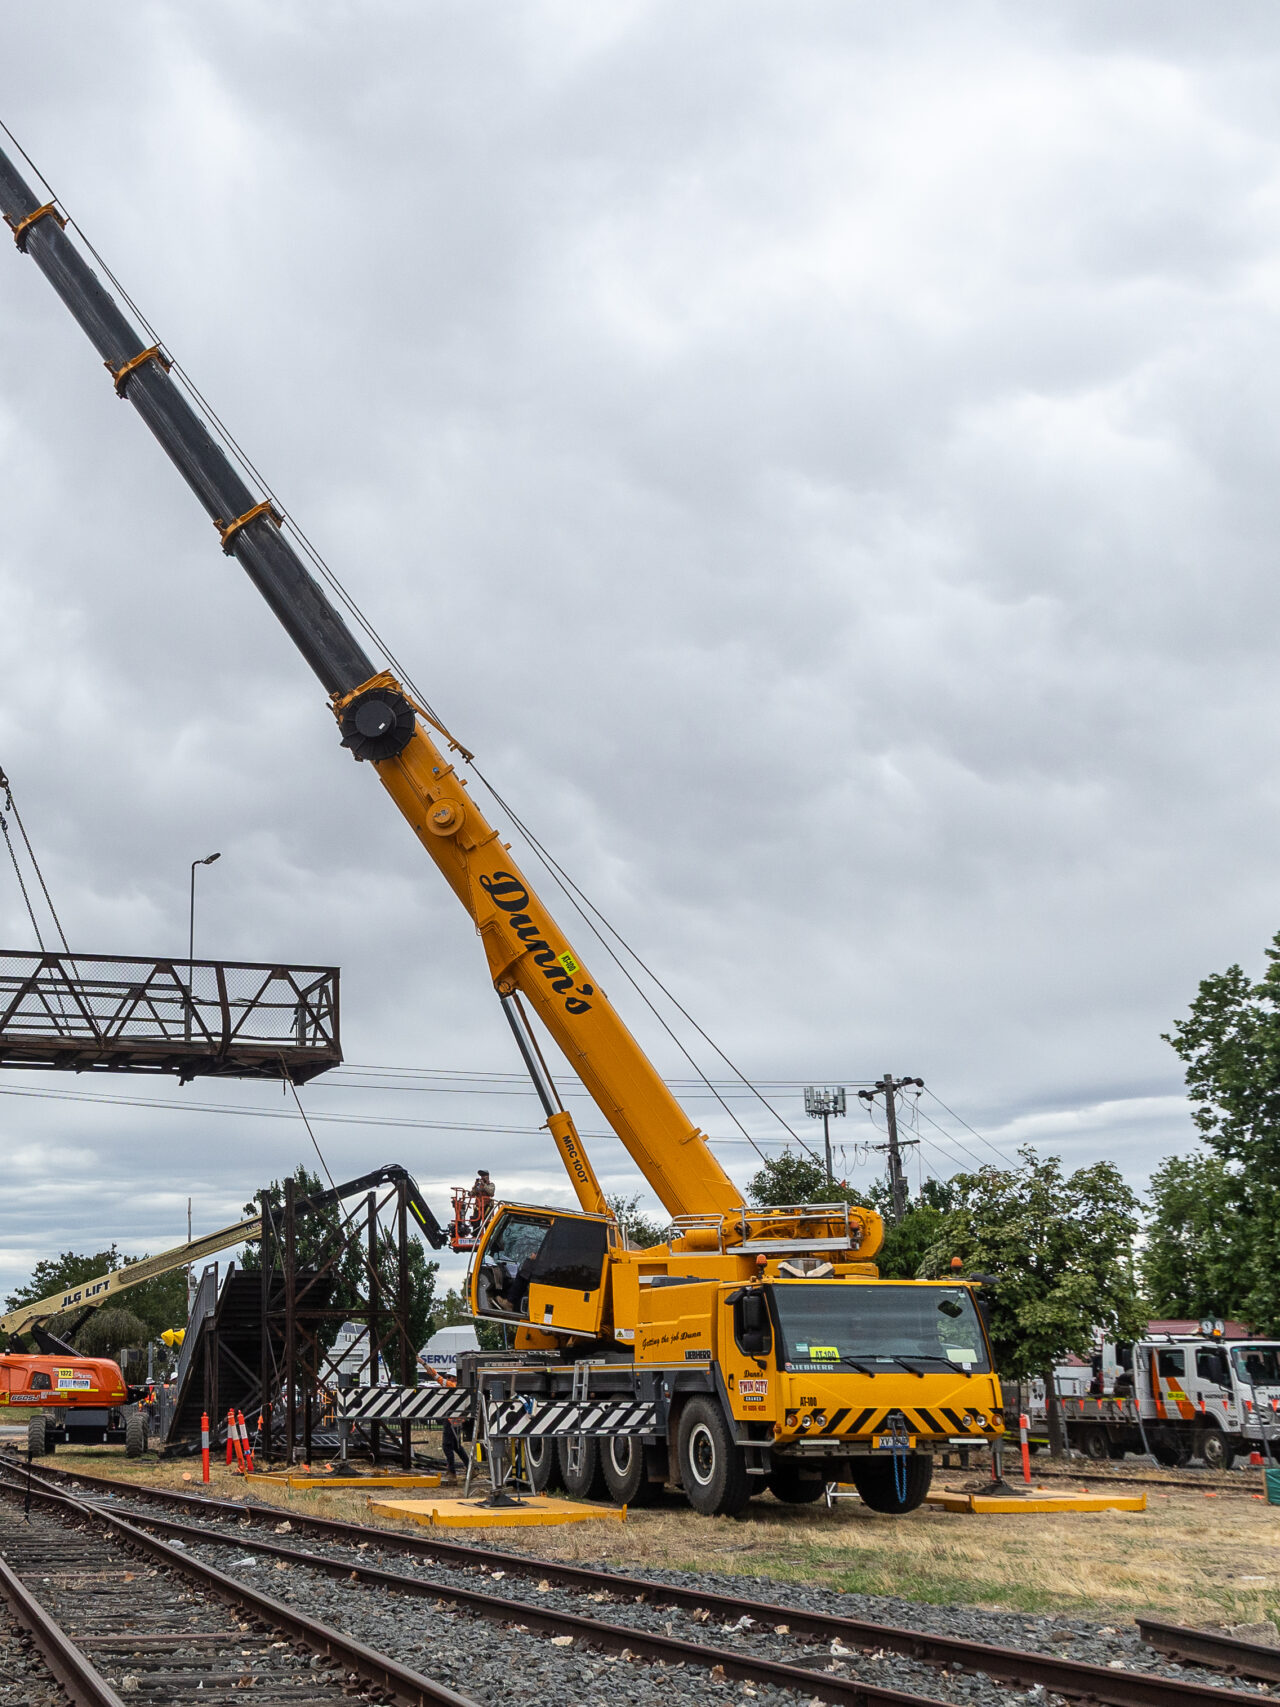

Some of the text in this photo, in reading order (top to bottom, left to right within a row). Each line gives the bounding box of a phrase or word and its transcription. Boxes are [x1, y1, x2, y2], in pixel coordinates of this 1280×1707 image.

[479, 871, 594, 1015] Dunn's
[561, 954, 577, 972] AT-100
[61, 1280, 110, 1308] JLG LIFT
[642, 1331, 702, 1350] Getting the job Dunn
[684, 1350, 711, 1360] LIEBHERR
[743, 1369, 764, 1378] Dunn's
[739, 1380, 768, 1395] TWIN CITY
[800, 1396, 817, 1407] AT-100
